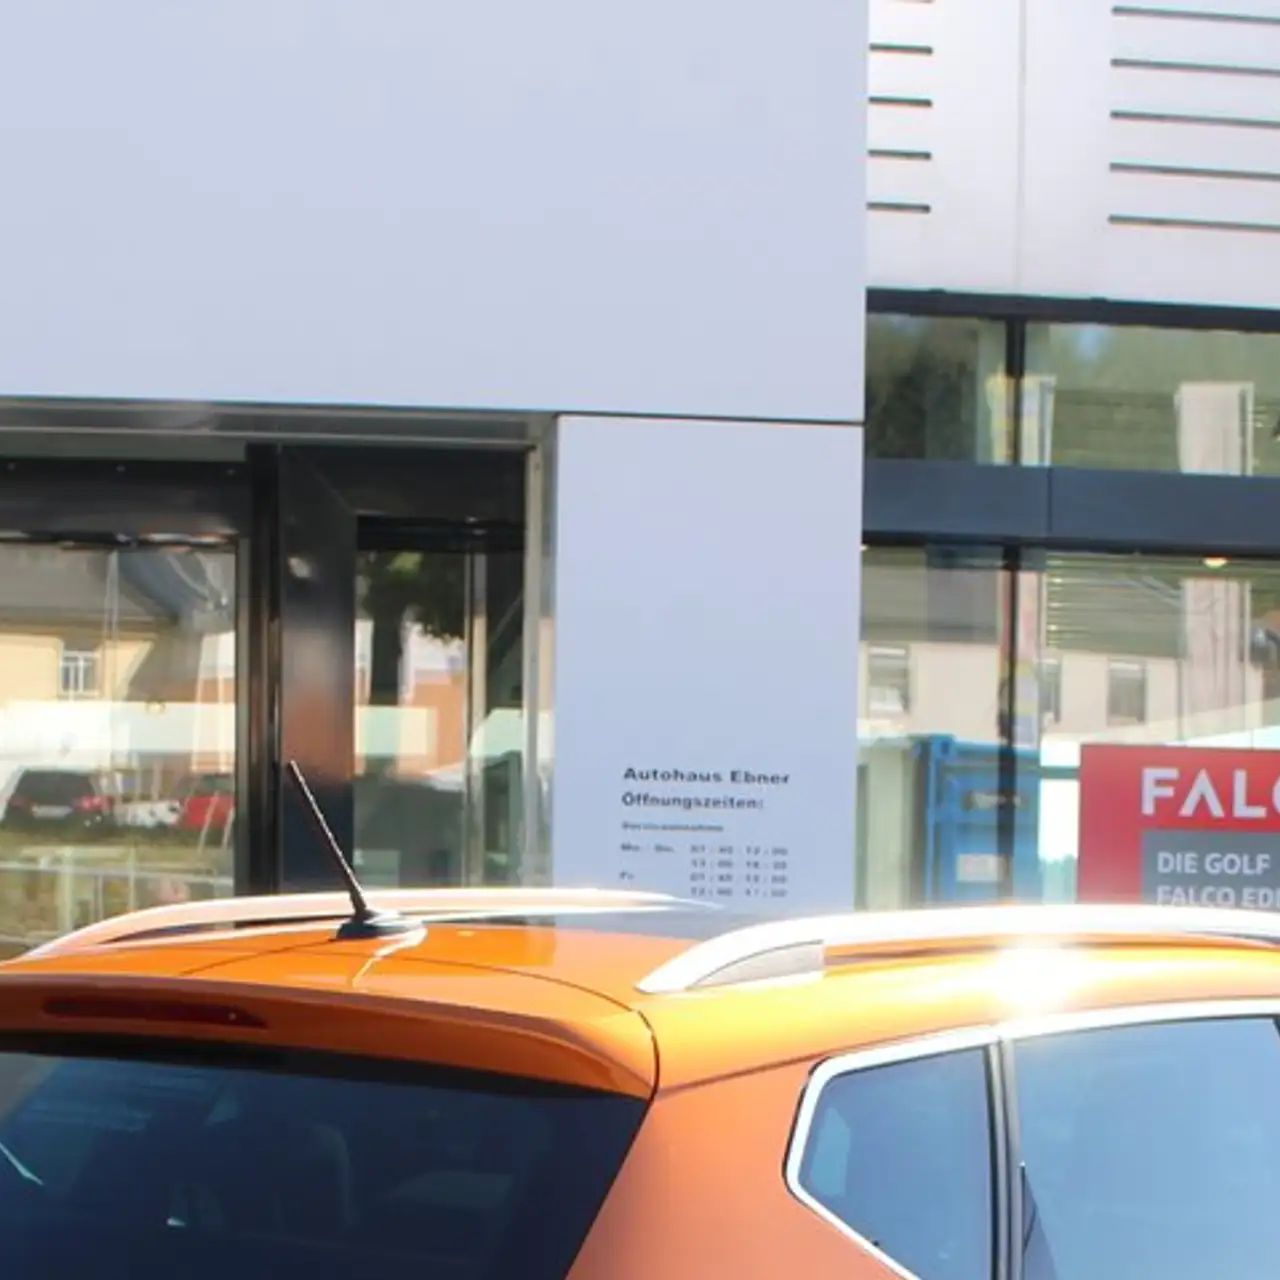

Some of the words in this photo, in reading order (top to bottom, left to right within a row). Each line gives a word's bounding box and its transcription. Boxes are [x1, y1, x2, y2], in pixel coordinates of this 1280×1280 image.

[623, 766, 723, 784] Autohaus
[729, 768, 790, 785] Ebner
[1156, 851, 1199, 875] DIE
[1204, 852, 1271, 877] GOLF
[1155, 885, 1236, 909] FALCO
